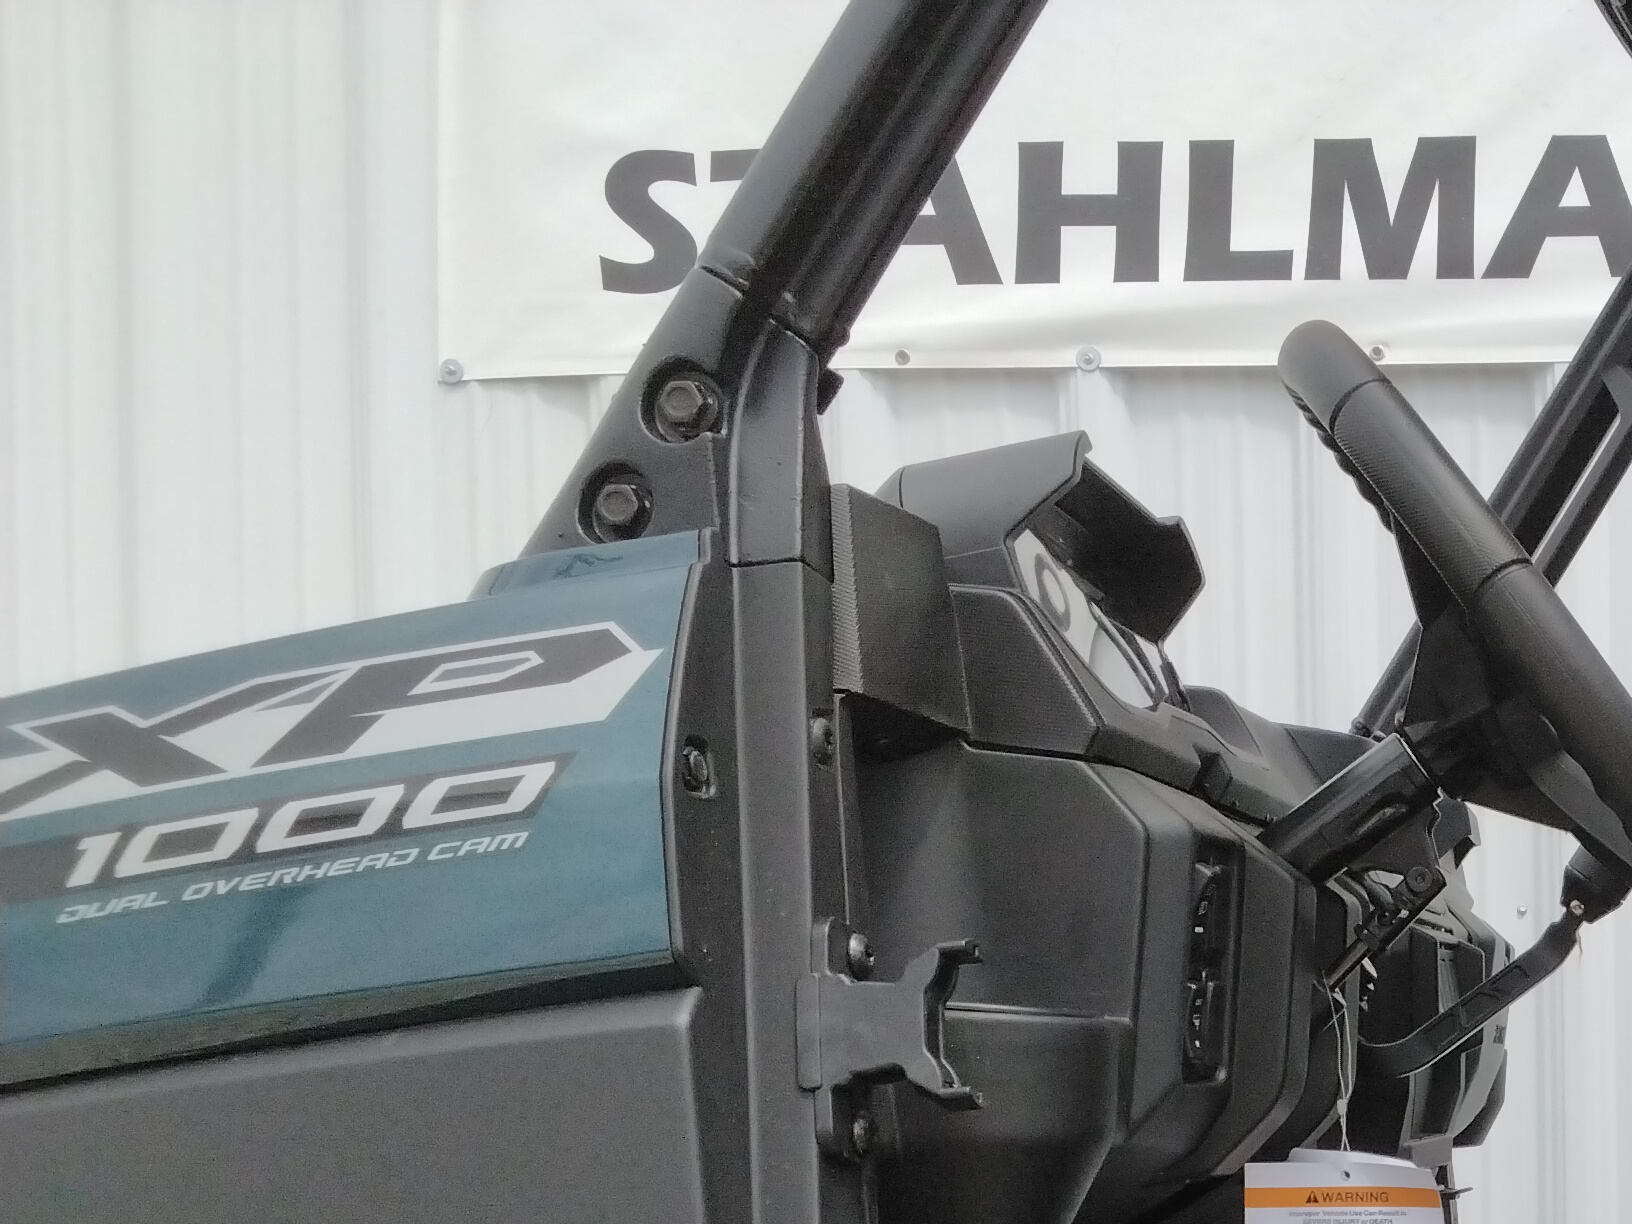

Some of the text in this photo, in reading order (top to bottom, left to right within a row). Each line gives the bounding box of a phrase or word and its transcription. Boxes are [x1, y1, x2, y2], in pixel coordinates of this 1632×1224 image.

[0, 621, 664, 821] XP
[56, 831, 530, 924] DUAL OVERHEAD CAM
[66, 762, 556, 888] 1000
[1321, 1191, 1389, 1203] WARNING
